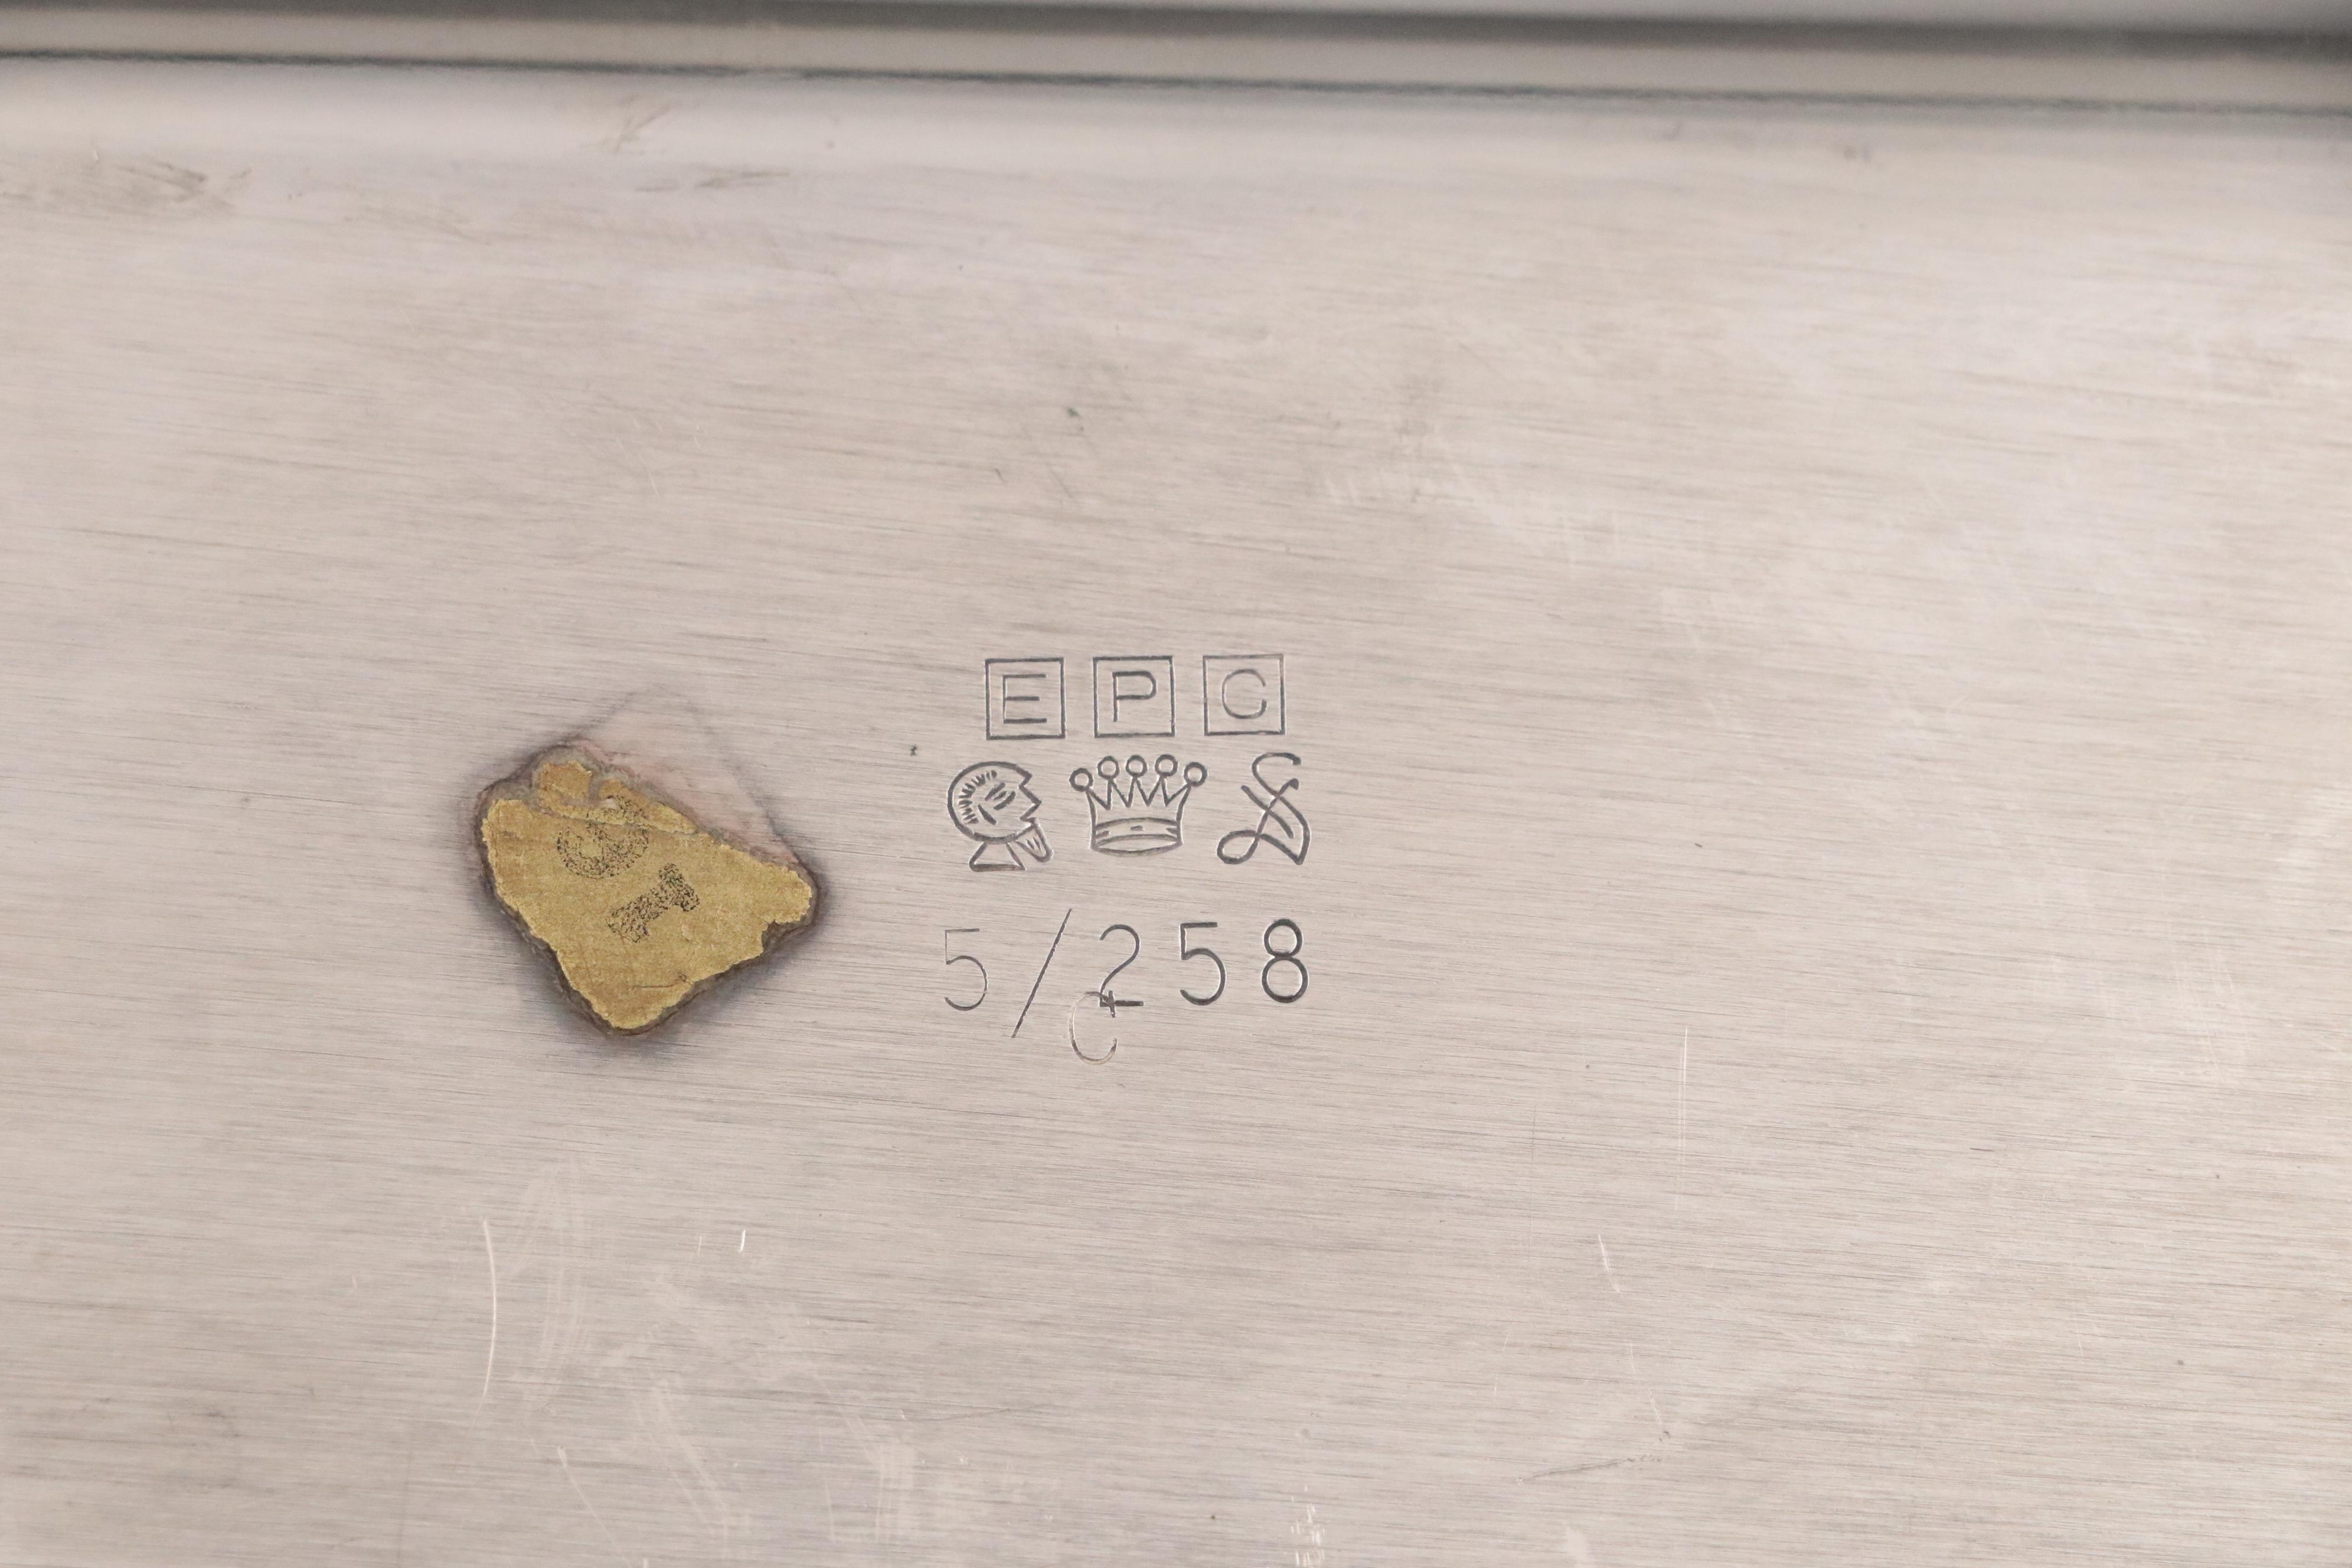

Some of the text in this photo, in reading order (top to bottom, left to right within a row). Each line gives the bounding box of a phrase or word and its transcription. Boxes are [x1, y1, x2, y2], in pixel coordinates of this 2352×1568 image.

[1002, 668, 1268, 724] E P C
[944, 908, 1309, 1038] 5/258
